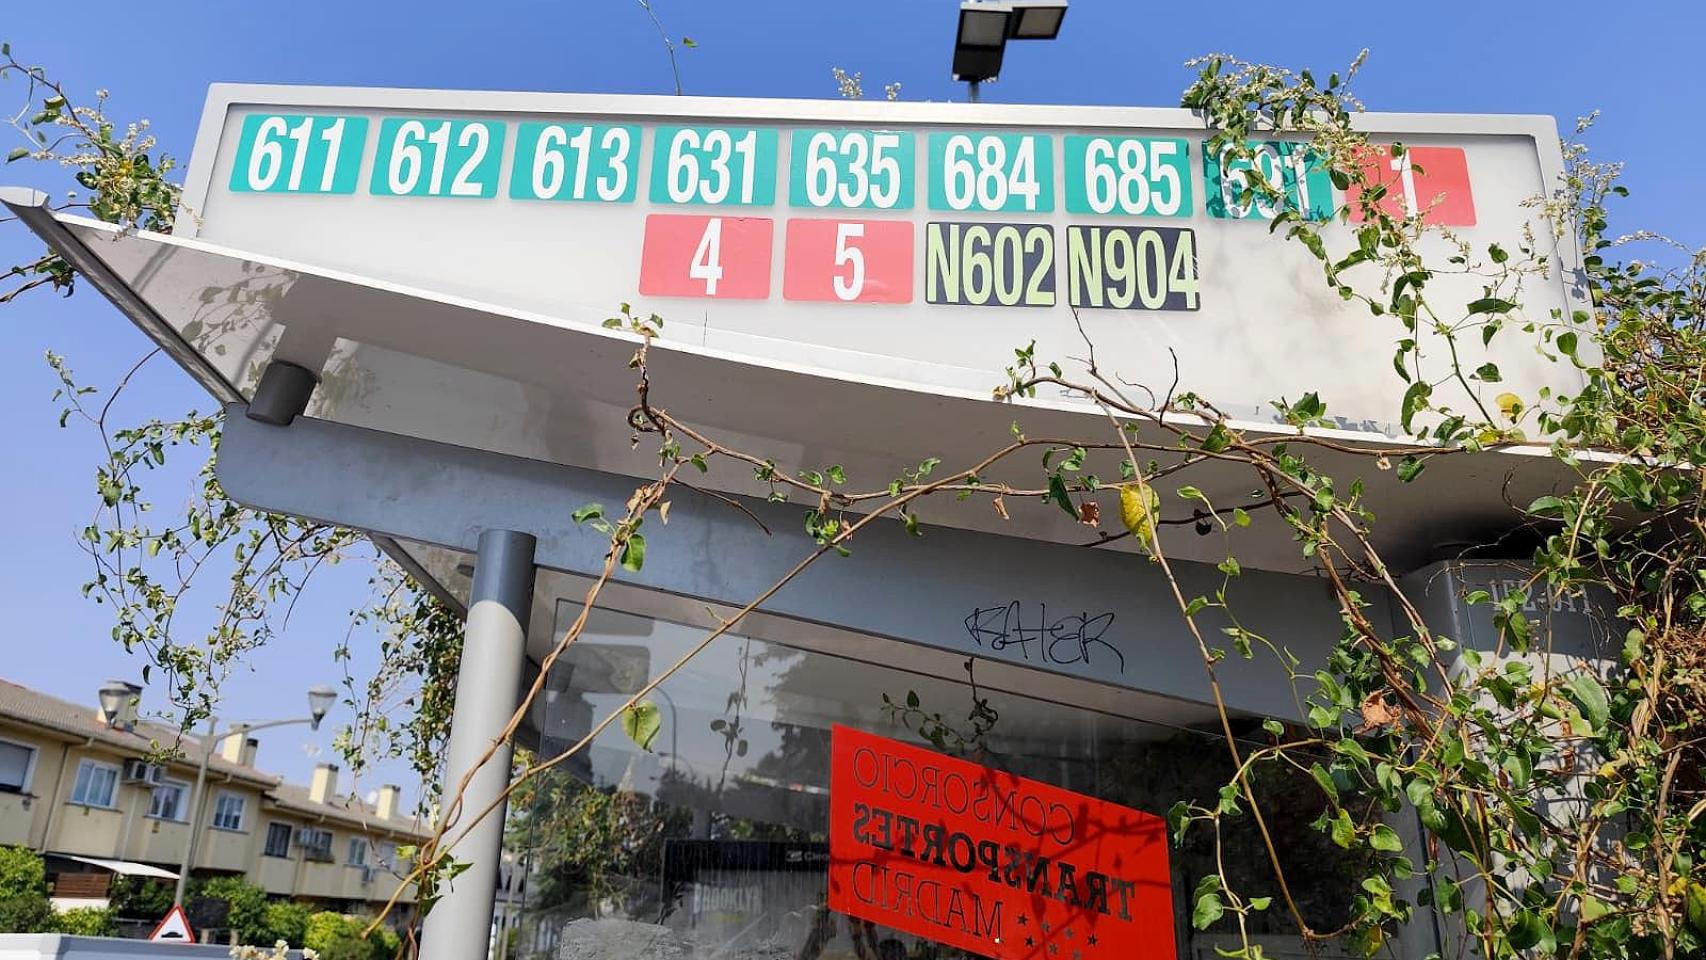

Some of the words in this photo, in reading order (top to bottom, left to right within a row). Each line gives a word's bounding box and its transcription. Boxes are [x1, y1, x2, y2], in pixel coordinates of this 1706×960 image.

[247, 116, 345, 192] 611
[388, 120, 490, 197] 612
[532, 125, 631, 201] 613
[667, 129, 758, 204] 631
[805, 131, 901, 209] 635
[944, 136, 1040, 212] 684
[1084, 139, 1182, 216] 685
[1390, 146, 1418, 219] 1
[689, 218, 723, 296] 4
[832, 223, 866, 301] 5
[927, 223, 1055, 306] N602
[1068, 227, 1199, 310] N904
